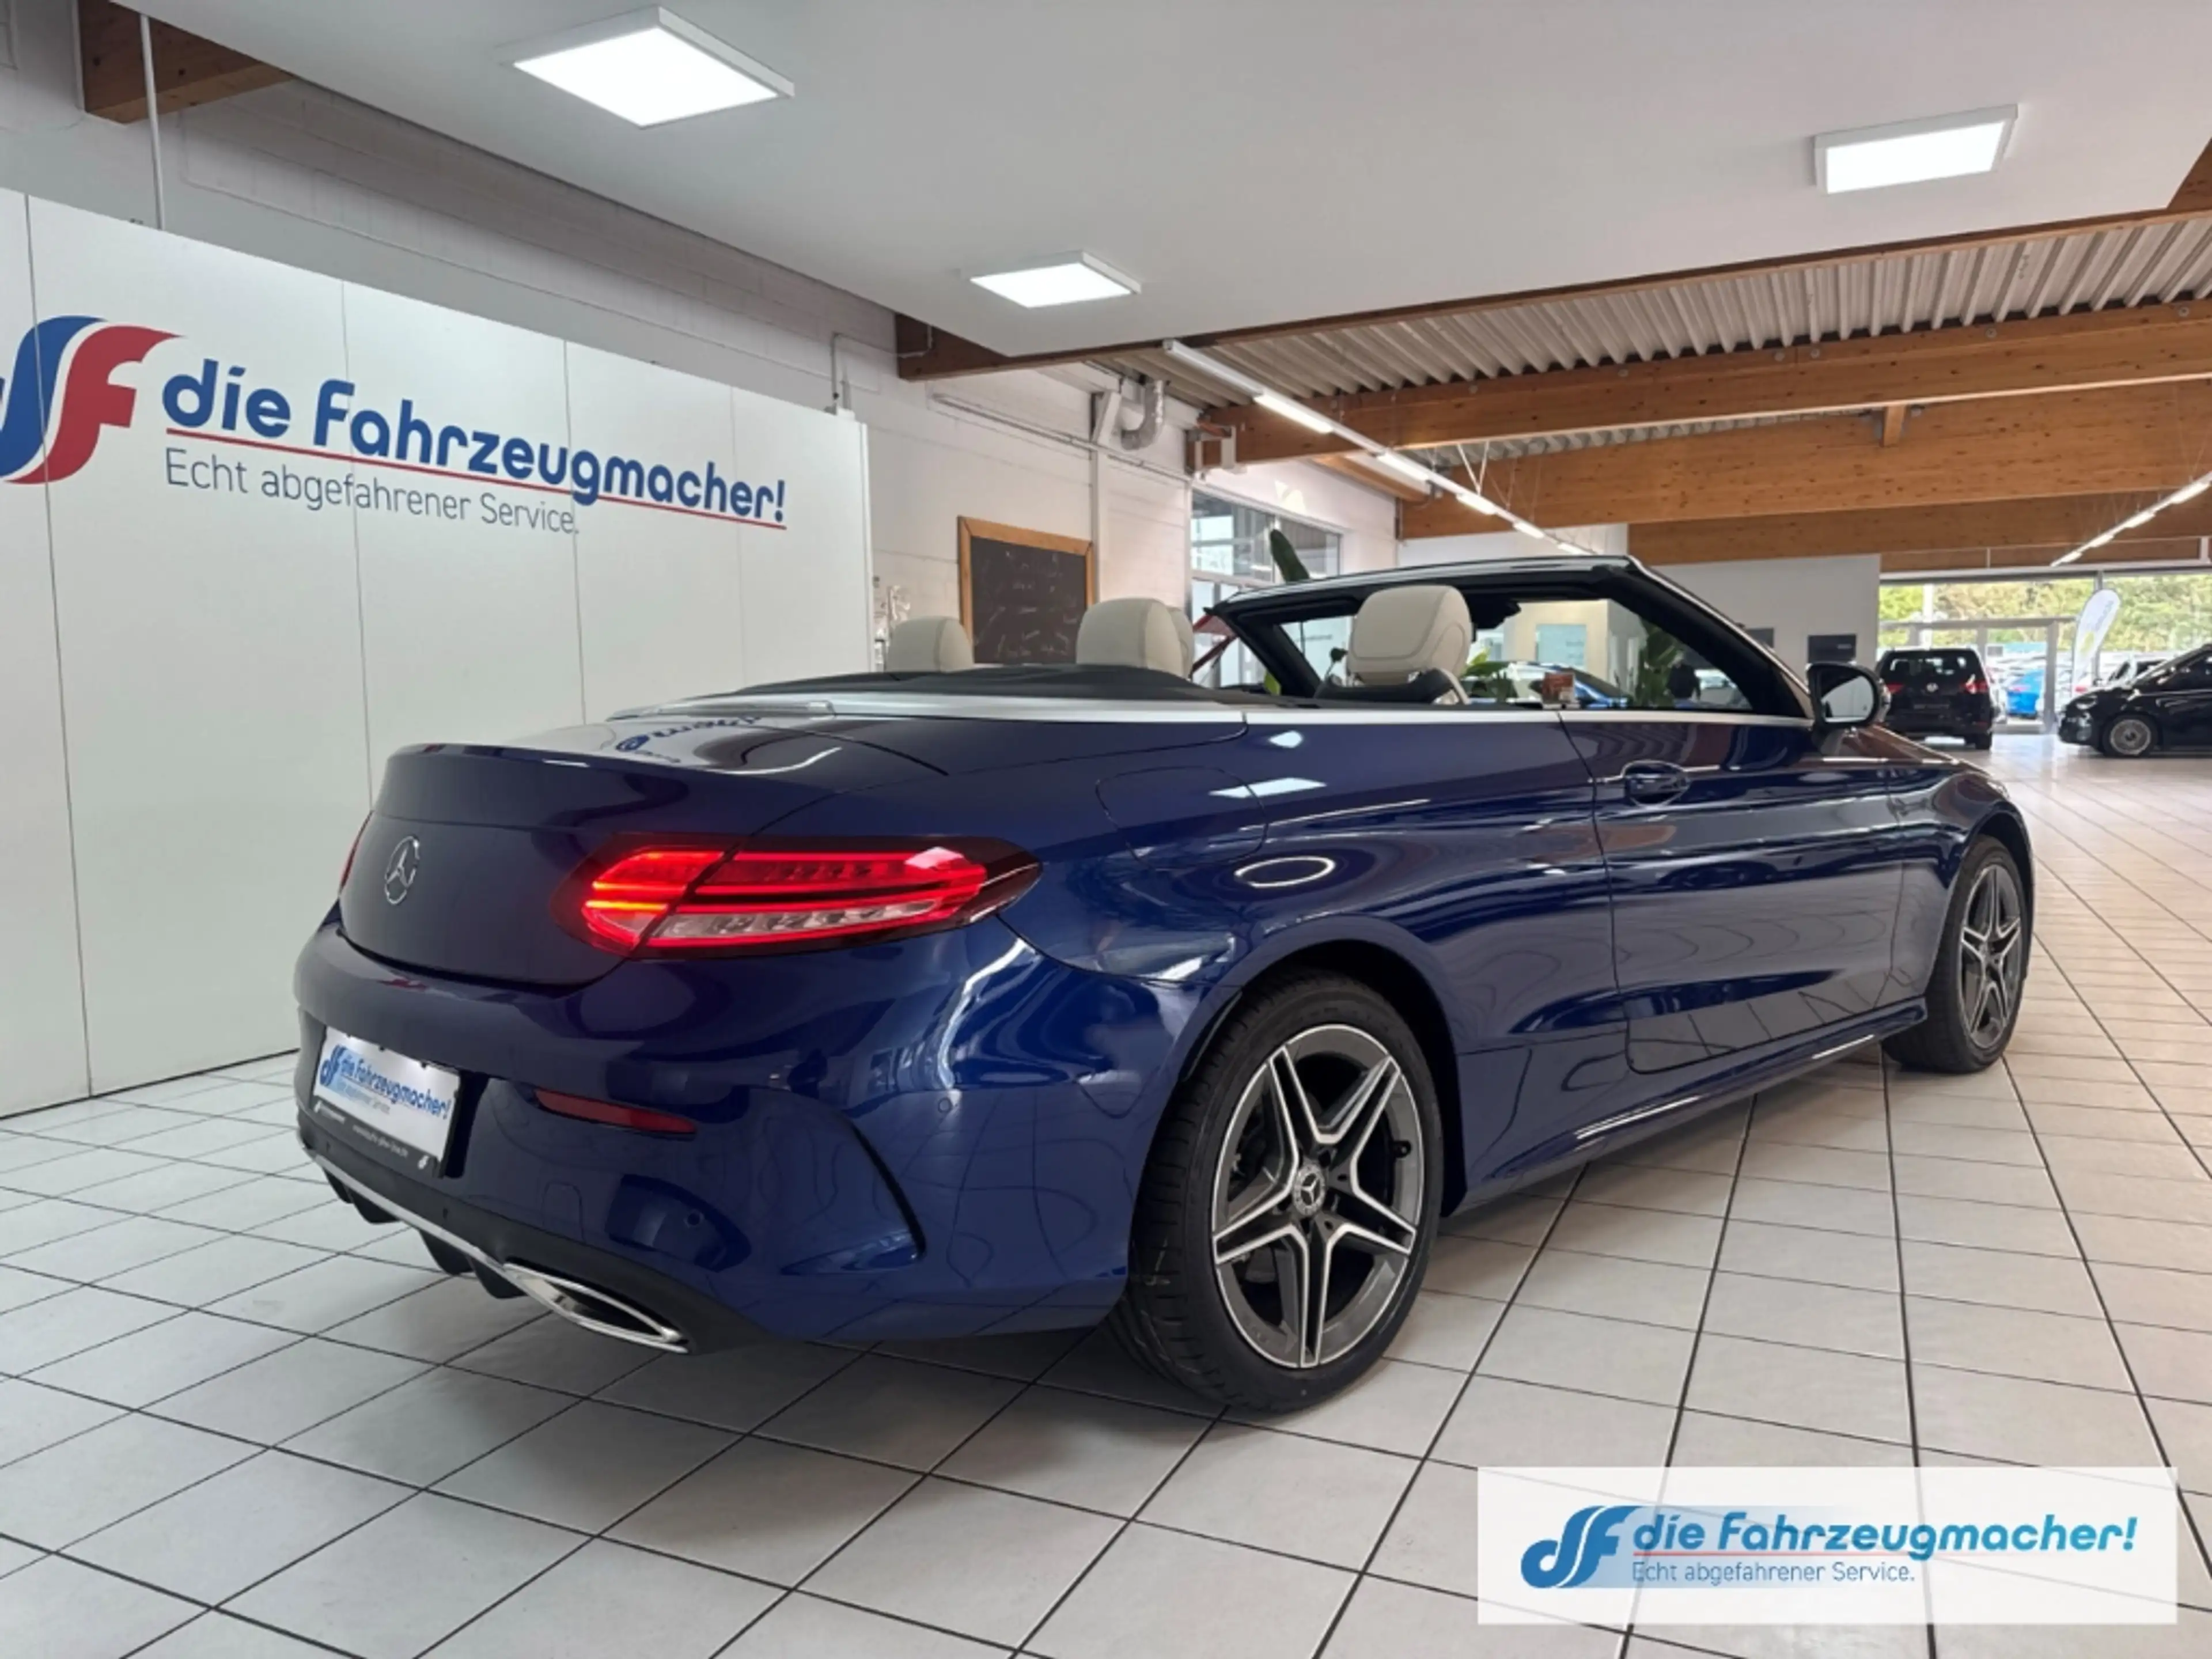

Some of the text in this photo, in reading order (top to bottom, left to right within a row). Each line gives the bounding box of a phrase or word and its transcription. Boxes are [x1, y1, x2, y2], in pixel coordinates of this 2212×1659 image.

[162, 359, 785, 522] die Fahrzeugmacher!
[166, 448, 248, 494] Echt
[262, 464, 471, 520] abgefahrener
